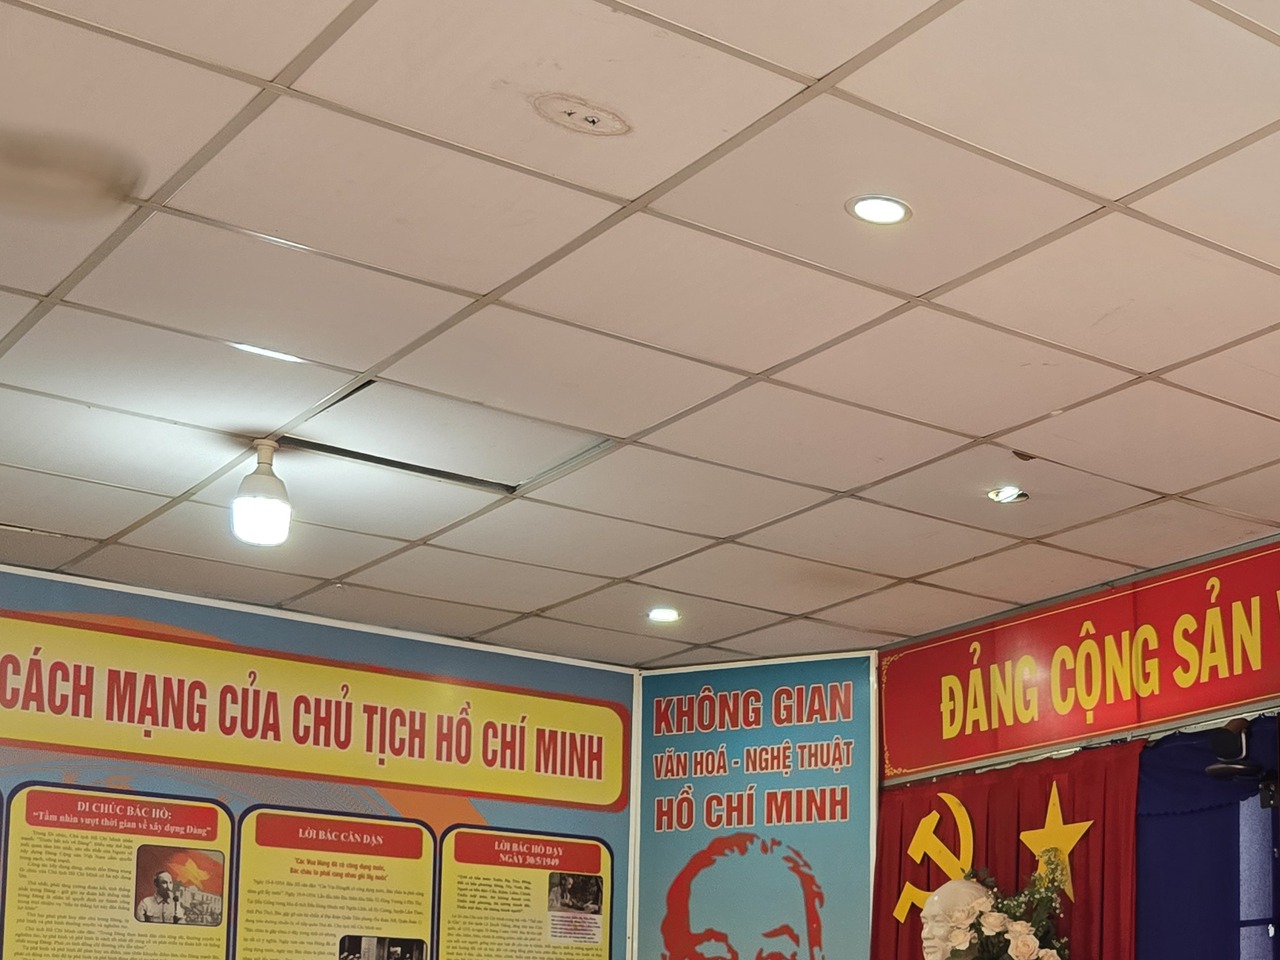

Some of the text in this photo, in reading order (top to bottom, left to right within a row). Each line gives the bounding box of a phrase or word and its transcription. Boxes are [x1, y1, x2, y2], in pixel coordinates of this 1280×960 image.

[940, 641, 1038, 739] ĐẢNG
[1051, 621, 1159, 724] CỘNG
[1172, 576, 1262, 689] SẢN
[0, 646, 603, 780] CÁCH MẠNG CỦA CHỦ TỊCH HỒ CHÍ MINH
[653, 681, 853, 735] KHÔNG GIAN
[653, 735, 854, 780] VĂN HOÁ - NGHỆ THUẬT
[77, 799, 172, 820] DI CHÚC BÁC HỒ:
[119, 819, 136, 830] gian
[655, 784, 850, 832] HỒ CHÍ MINH
[298, 826, 316, 839] LỜI
[318, 828, 340, 841] BÁC
[495, 839, 510, 851] LỜI
[512, 841, 530, 852] BÁC
